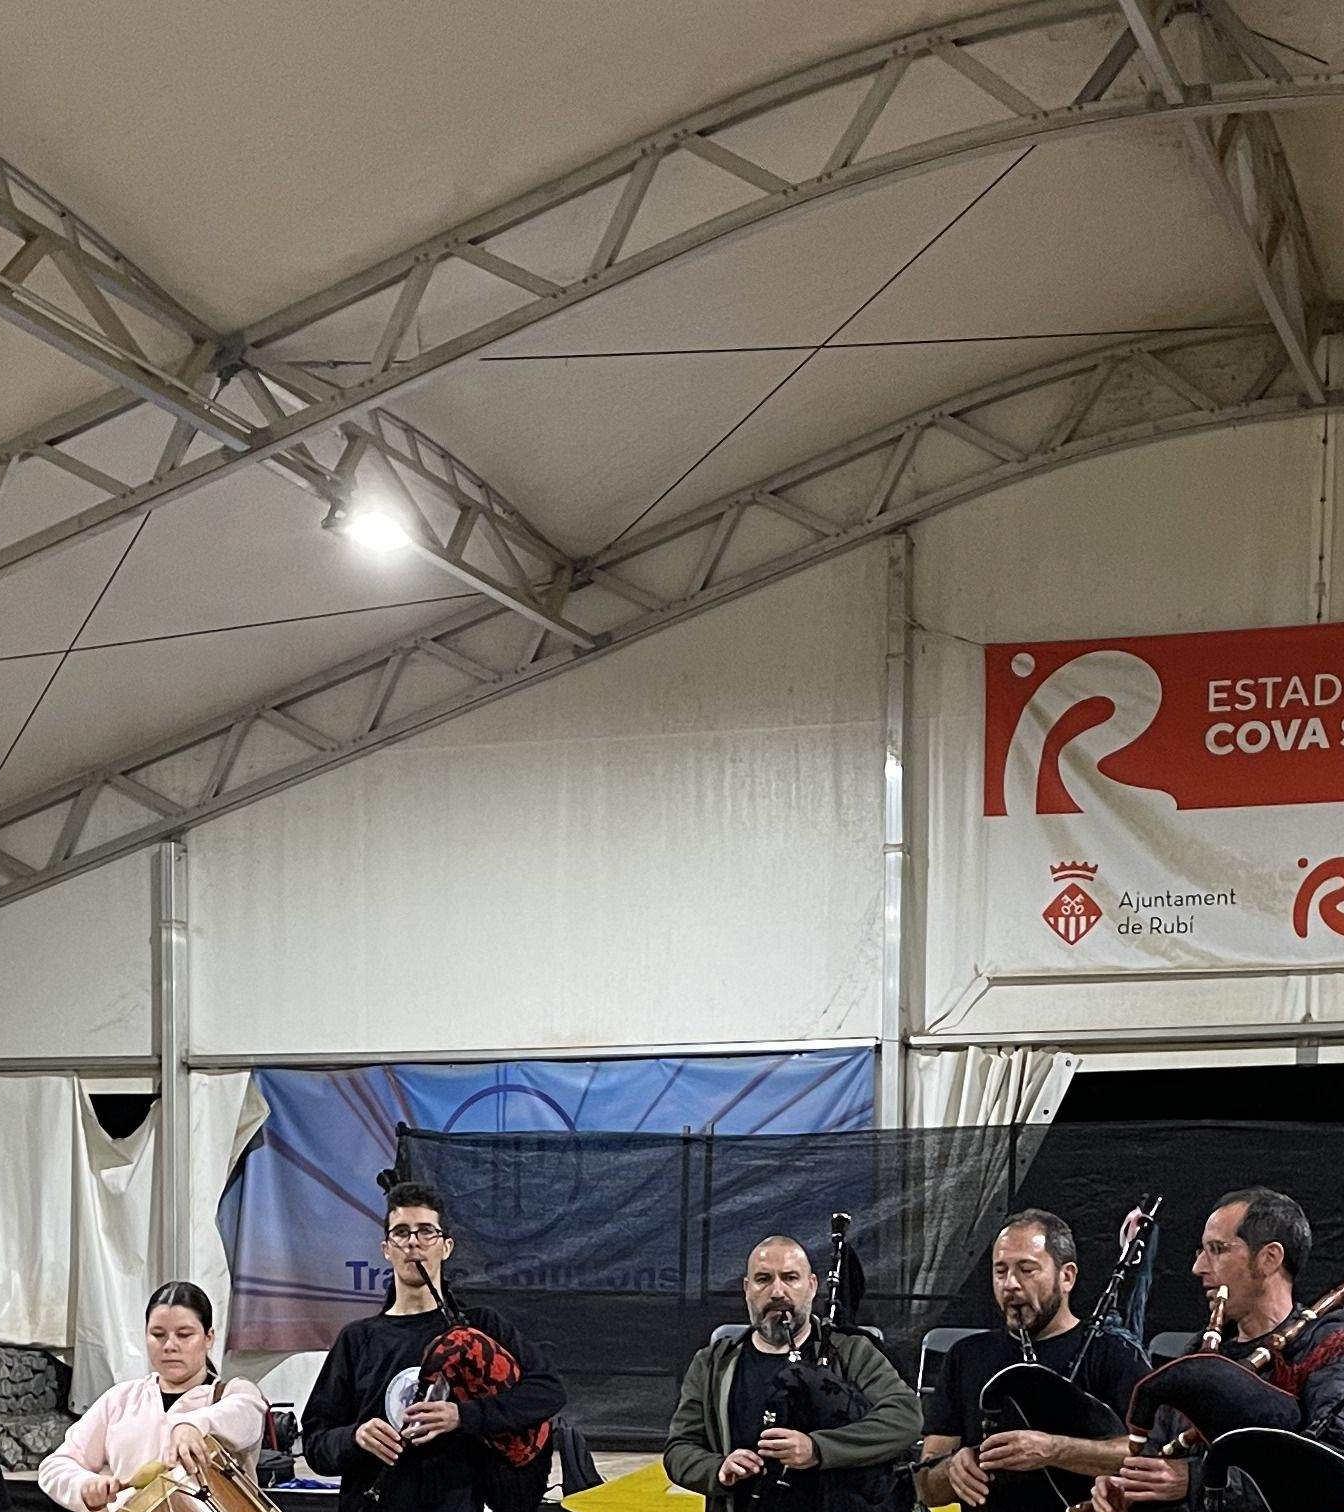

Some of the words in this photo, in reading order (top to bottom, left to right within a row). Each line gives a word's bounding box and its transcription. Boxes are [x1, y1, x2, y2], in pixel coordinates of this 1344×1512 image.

[1203, 716, 1331, 756] COVA
[1118, 888, 1237, 913] Ajuntament
[1117, 916, 1143, 935] de
[1149, 915, 1194, 935] Rubí
